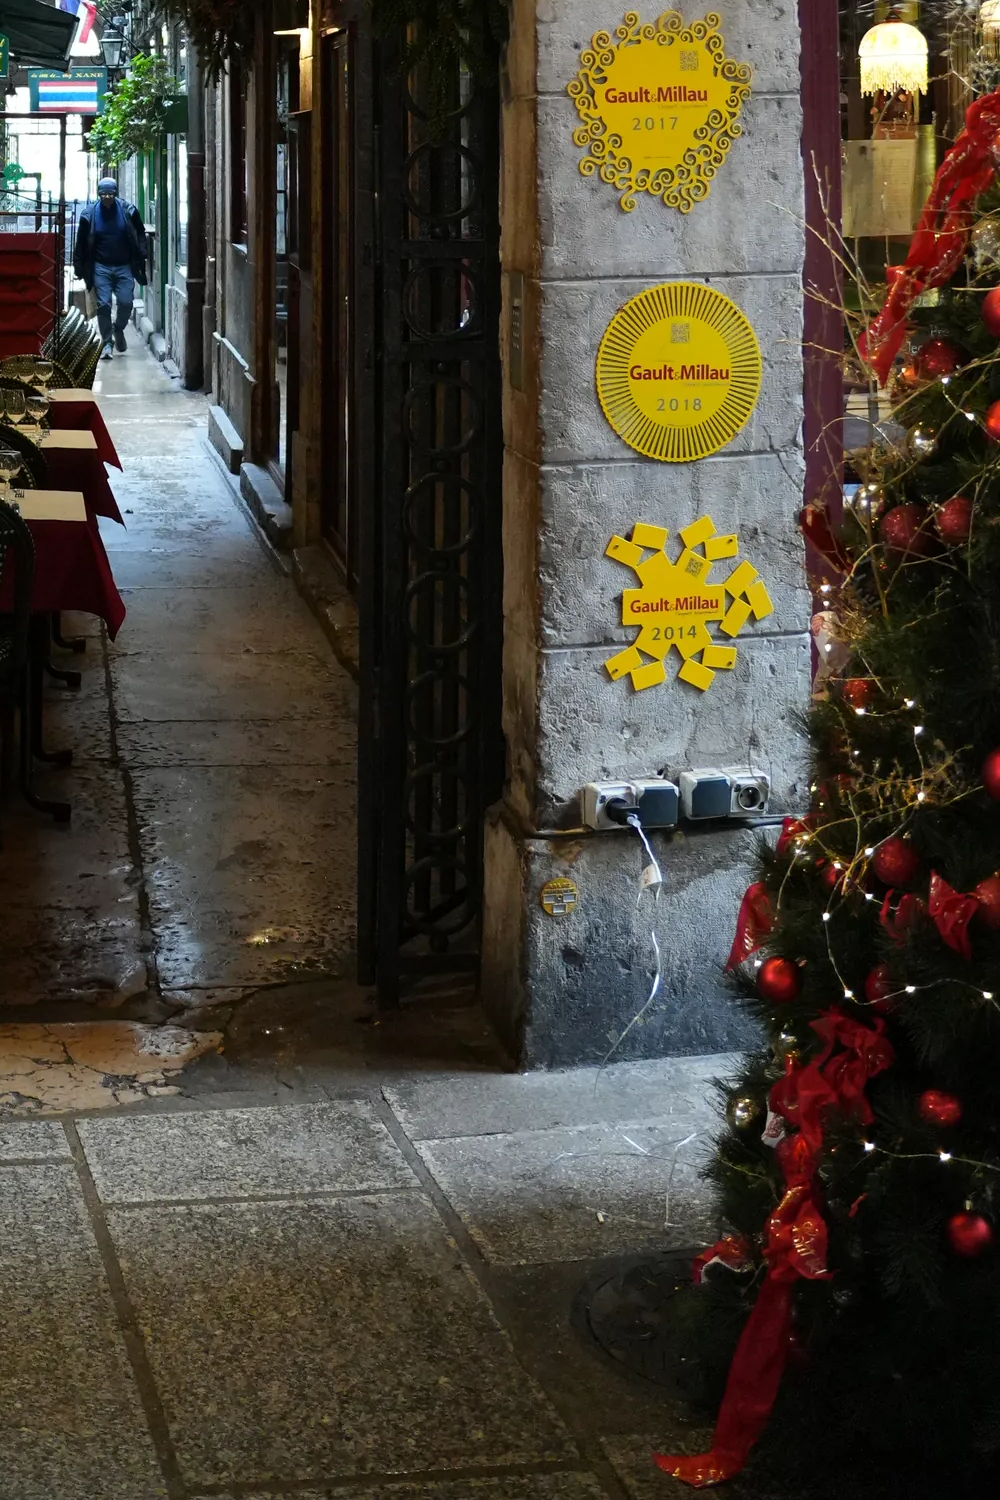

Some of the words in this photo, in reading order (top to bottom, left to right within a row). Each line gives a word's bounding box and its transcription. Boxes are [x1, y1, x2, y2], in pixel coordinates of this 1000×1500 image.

[604, 86, 708, 104] Gault&Millau
[632, 116, 679, 131] 2017
[629, 364, 730, 381] Gault&Millau
[657, 398, 702, 412] 2018
[630, 596, 719, 614] Gault&Millau
[652, 625, 697, 641] 2014
